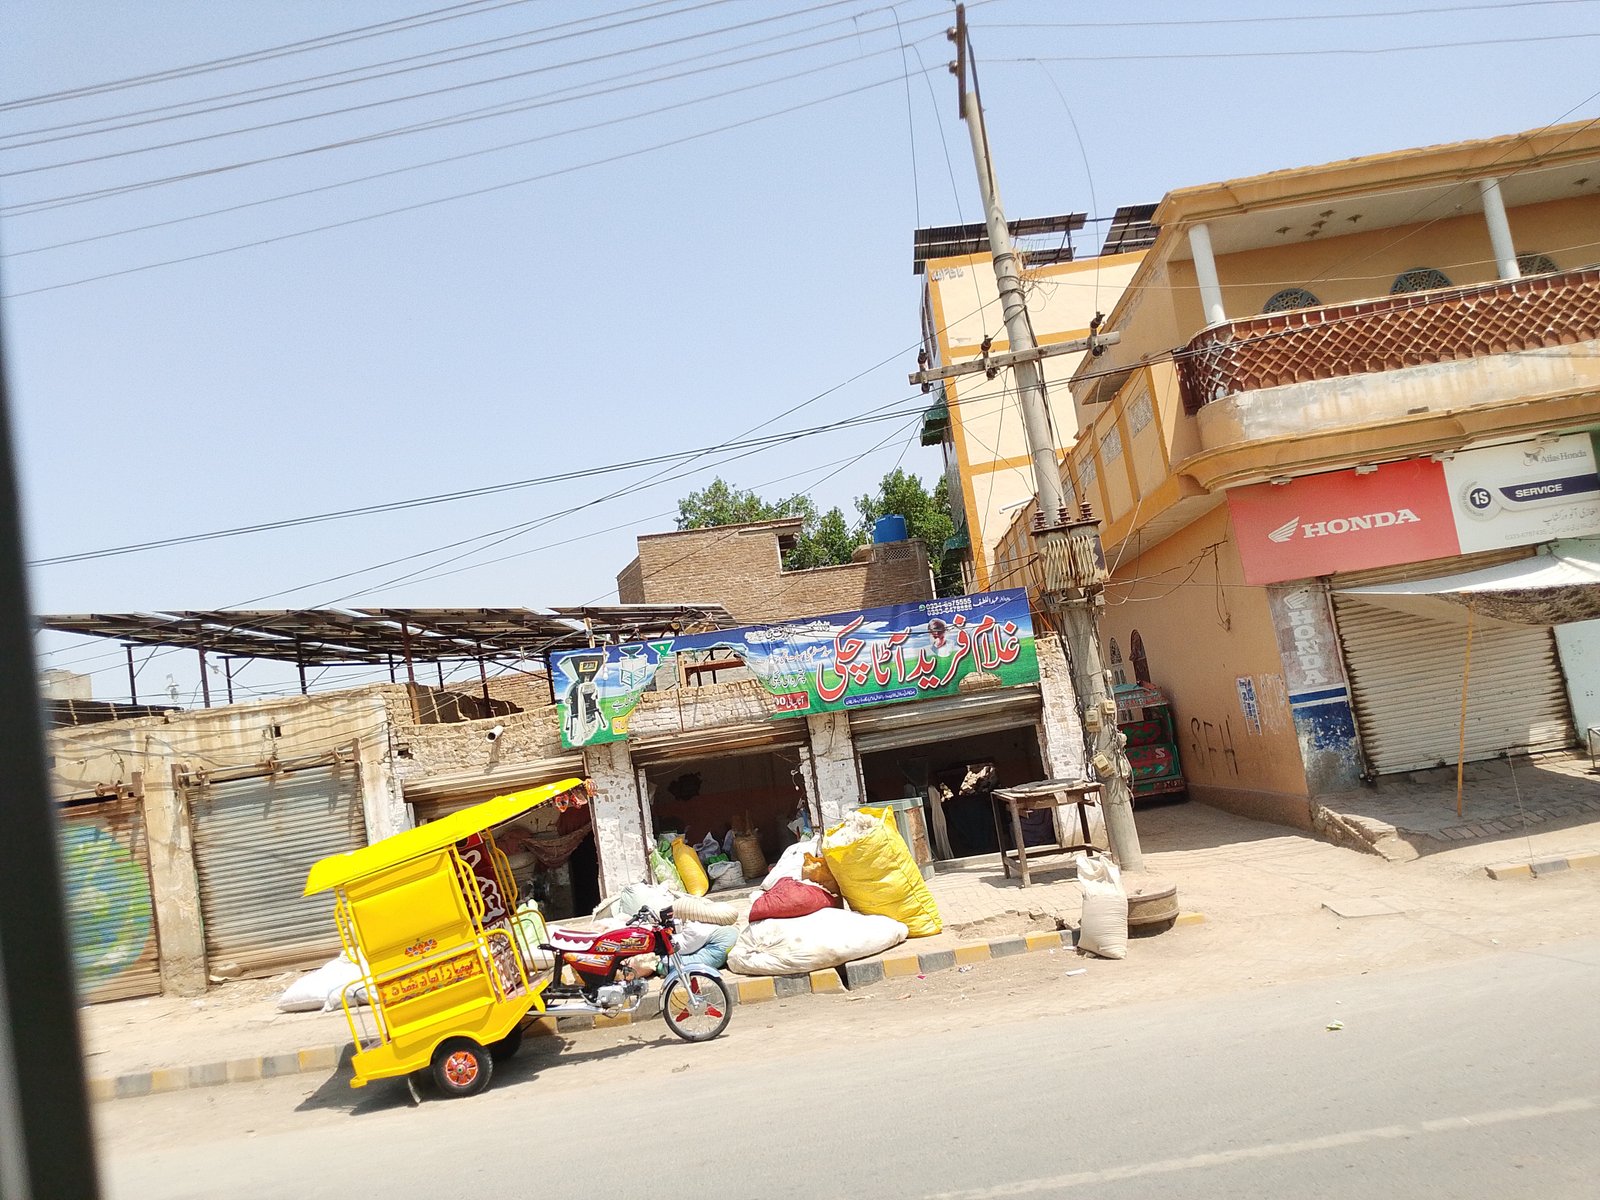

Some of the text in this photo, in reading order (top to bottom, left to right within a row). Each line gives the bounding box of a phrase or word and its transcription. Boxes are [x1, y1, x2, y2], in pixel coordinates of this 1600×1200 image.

[1540, 449, 1588, 464] Atlas Honda
[1471, 491, 1490, 506] 1S
[1514, 483, 1564, 499] SERVICE
[1301, 508, 1421, 539] HONDA
[815, 613, 1020, 702] غلام فرید آٹا چکی
[1288, 609, 1328, 685] HONDA
